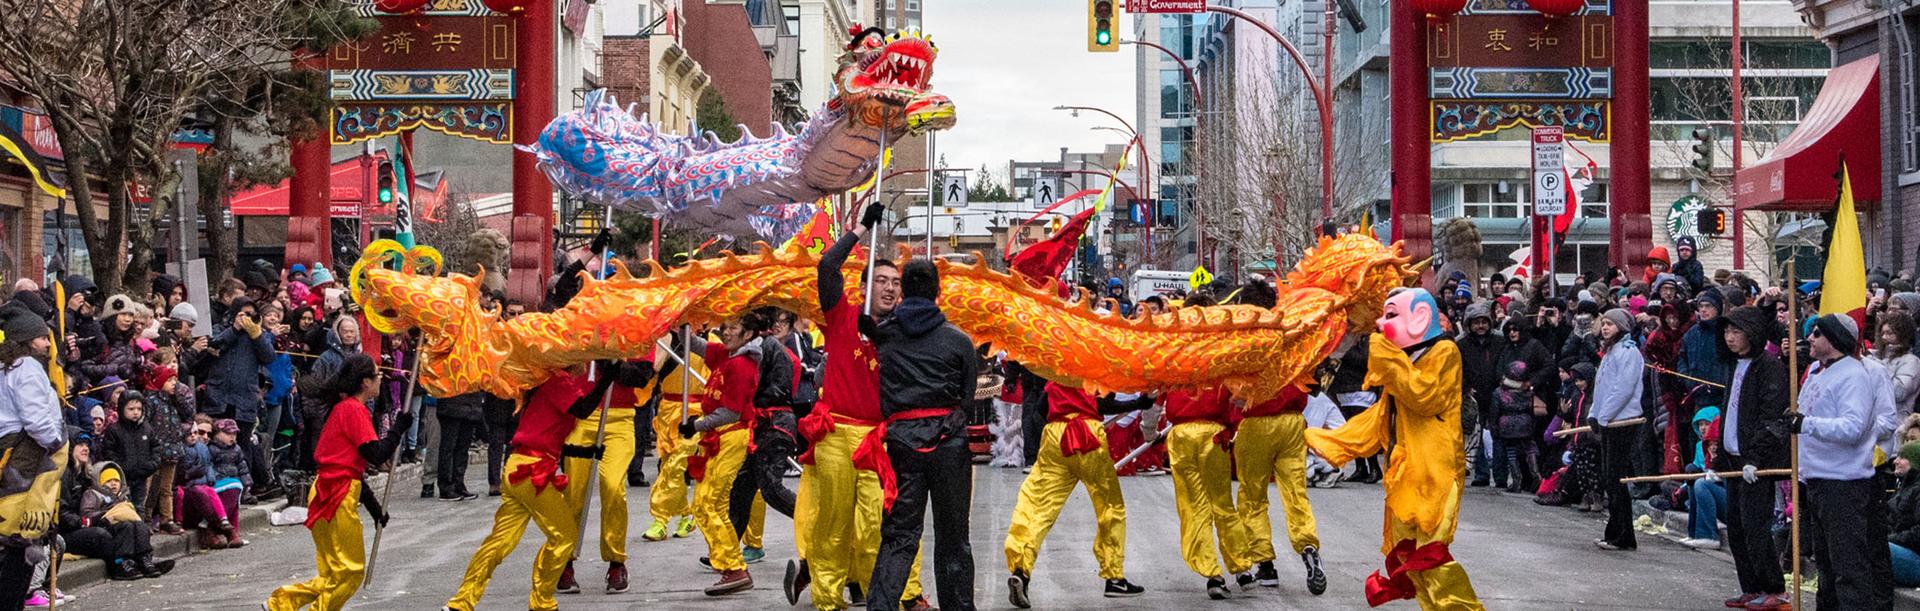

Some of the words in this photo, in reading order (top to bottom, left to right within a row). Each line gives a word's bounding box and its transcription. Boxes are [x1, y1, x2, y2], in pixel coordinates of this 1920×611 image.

[1149, 0, 1203, 10] Government
[1547, 176, 1555, 187] P
[1715, 212, 1725, 231] 3
[1153, 282, 1186, 290] U-HAUL
